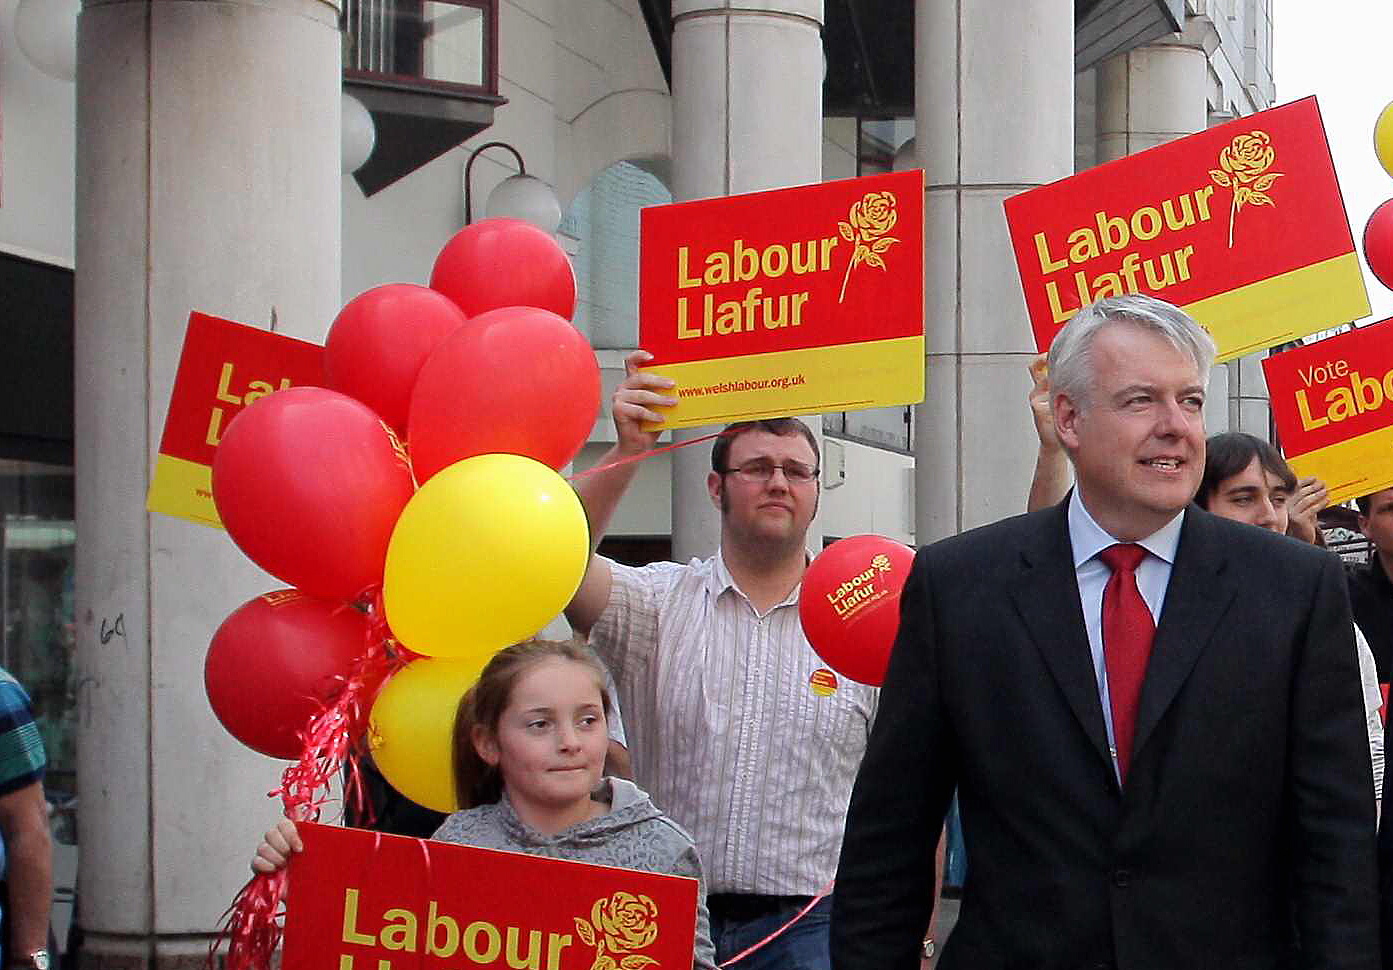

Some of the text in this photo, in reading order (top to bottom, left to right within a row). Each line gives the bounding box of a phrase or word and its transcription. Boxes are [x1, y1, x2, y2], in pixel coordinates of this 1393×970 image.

[1034, 184, 1215, 274] Labour
[678, 239, 839, 289] Labour
[1046, 246, 1194, 324] Llafur
[677, 287, 809, 340] Llafur
[678, 374, 806, 398] www.welshlabour.org.uk
[1298, 358, 1349, 388] Vote
[826, 567, 876, 605] Labour
[833, 584, 875, 616] Llafur
